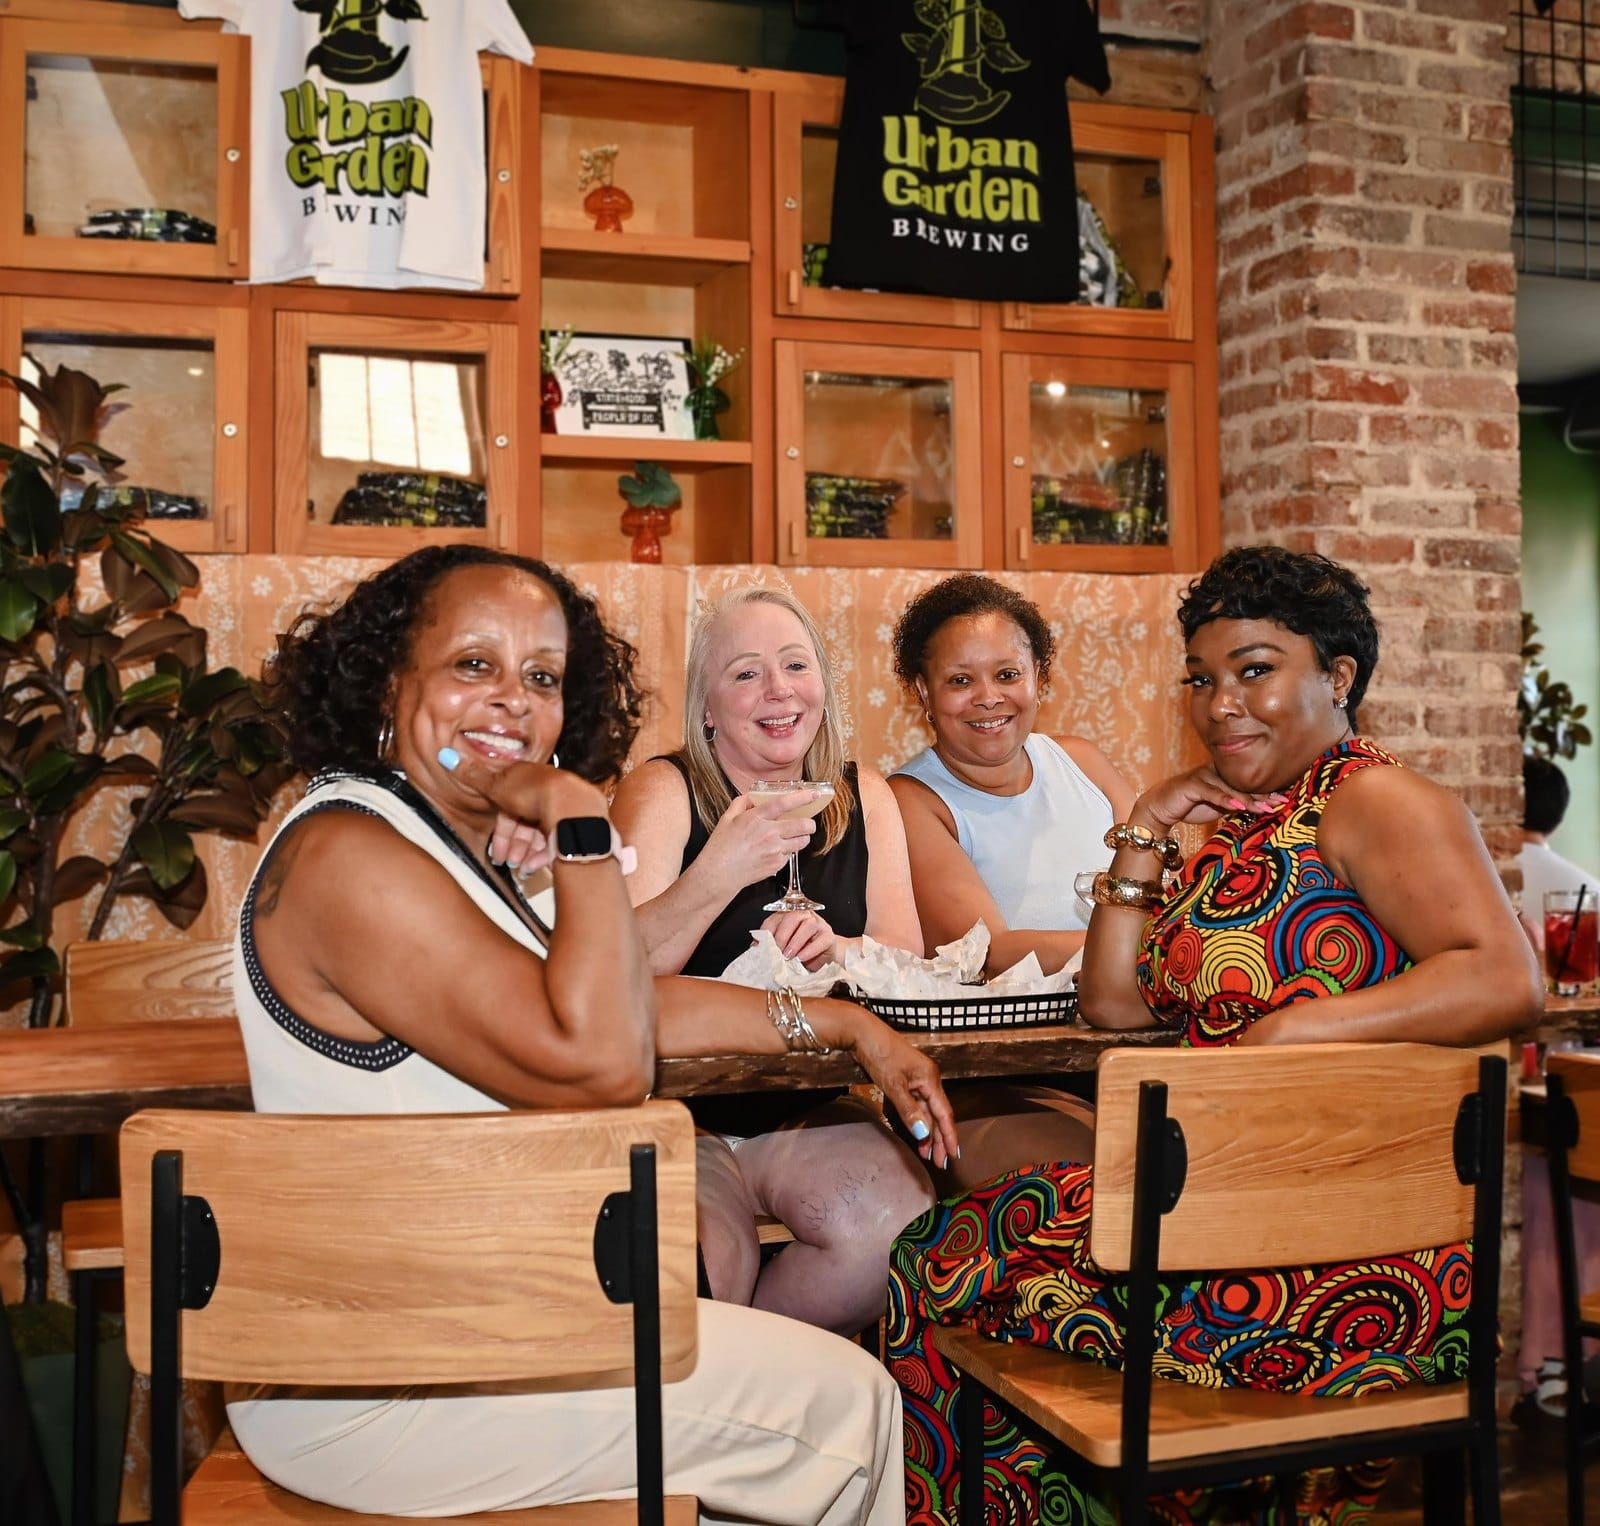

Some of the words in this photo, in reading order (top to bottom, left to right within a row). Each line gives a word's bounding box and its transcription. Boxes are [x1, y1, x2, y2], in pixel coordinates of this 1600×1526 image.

[286, 135, 428, 198] Grden
[882, 115, 1039, 176] Urban
[302, 196, 407, 227] BWIN
[882, 168, 1041, 222] Garden
[892, 217, 1029, 253] BREWING
